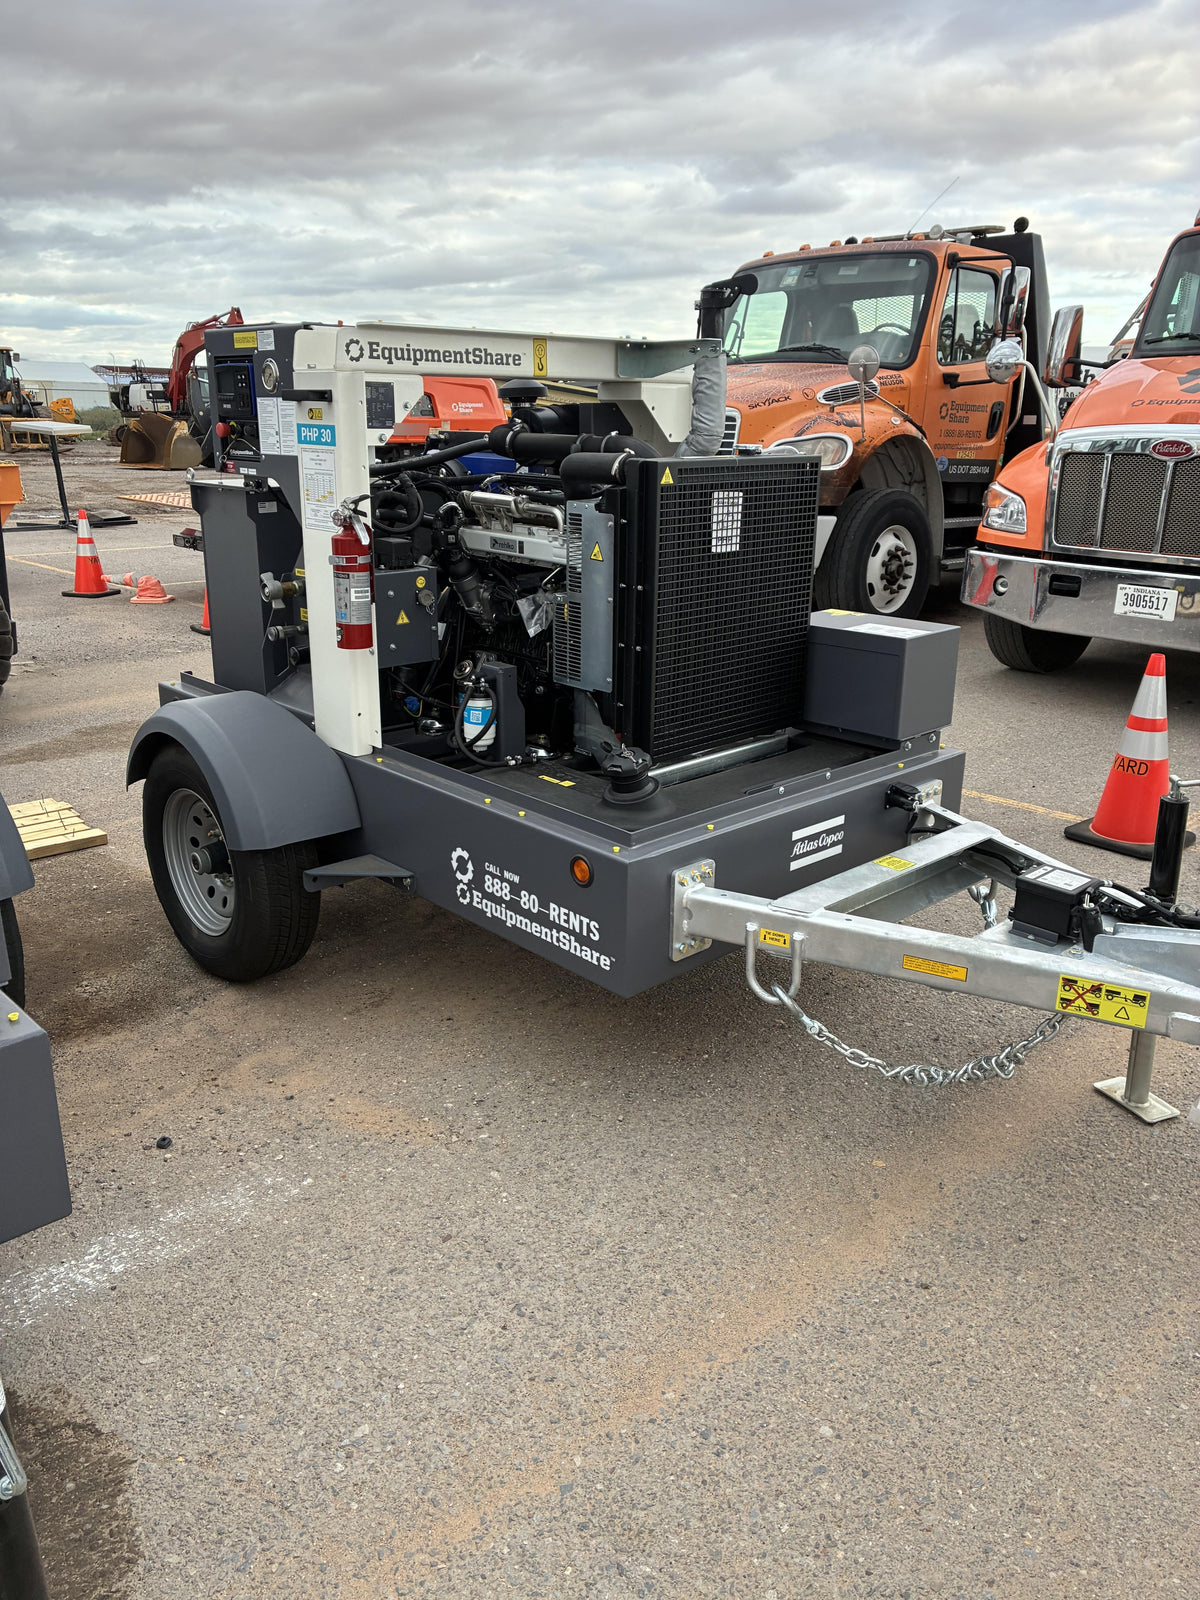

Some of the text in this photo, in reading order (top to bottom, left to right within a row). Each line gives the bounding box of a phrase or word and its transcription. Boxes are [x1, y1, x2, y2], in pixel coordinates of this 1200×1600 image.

[367, 339, 522, 367] EquipmentShare
[748, 394, 792, 410] SKYJACK
[950, 401, 988, 413] Equipment
[948, 413, 969, 423] Share
[301, 426, 332, 443] PHP 30
[1155, 443, 1191, 454] Peterbilt
[948, 465, 957, 474] US
[957, 465, 969, 474] DOT
[1133, 587, 1161, 596] INDIANA
[1122, 592, 1169, 612] 3905517
[790, 830, 845, 858] Atlas Copco
[484, 862, 520, 884] CALL NOW
[472, 889, 612, 971] EquipmentShare
